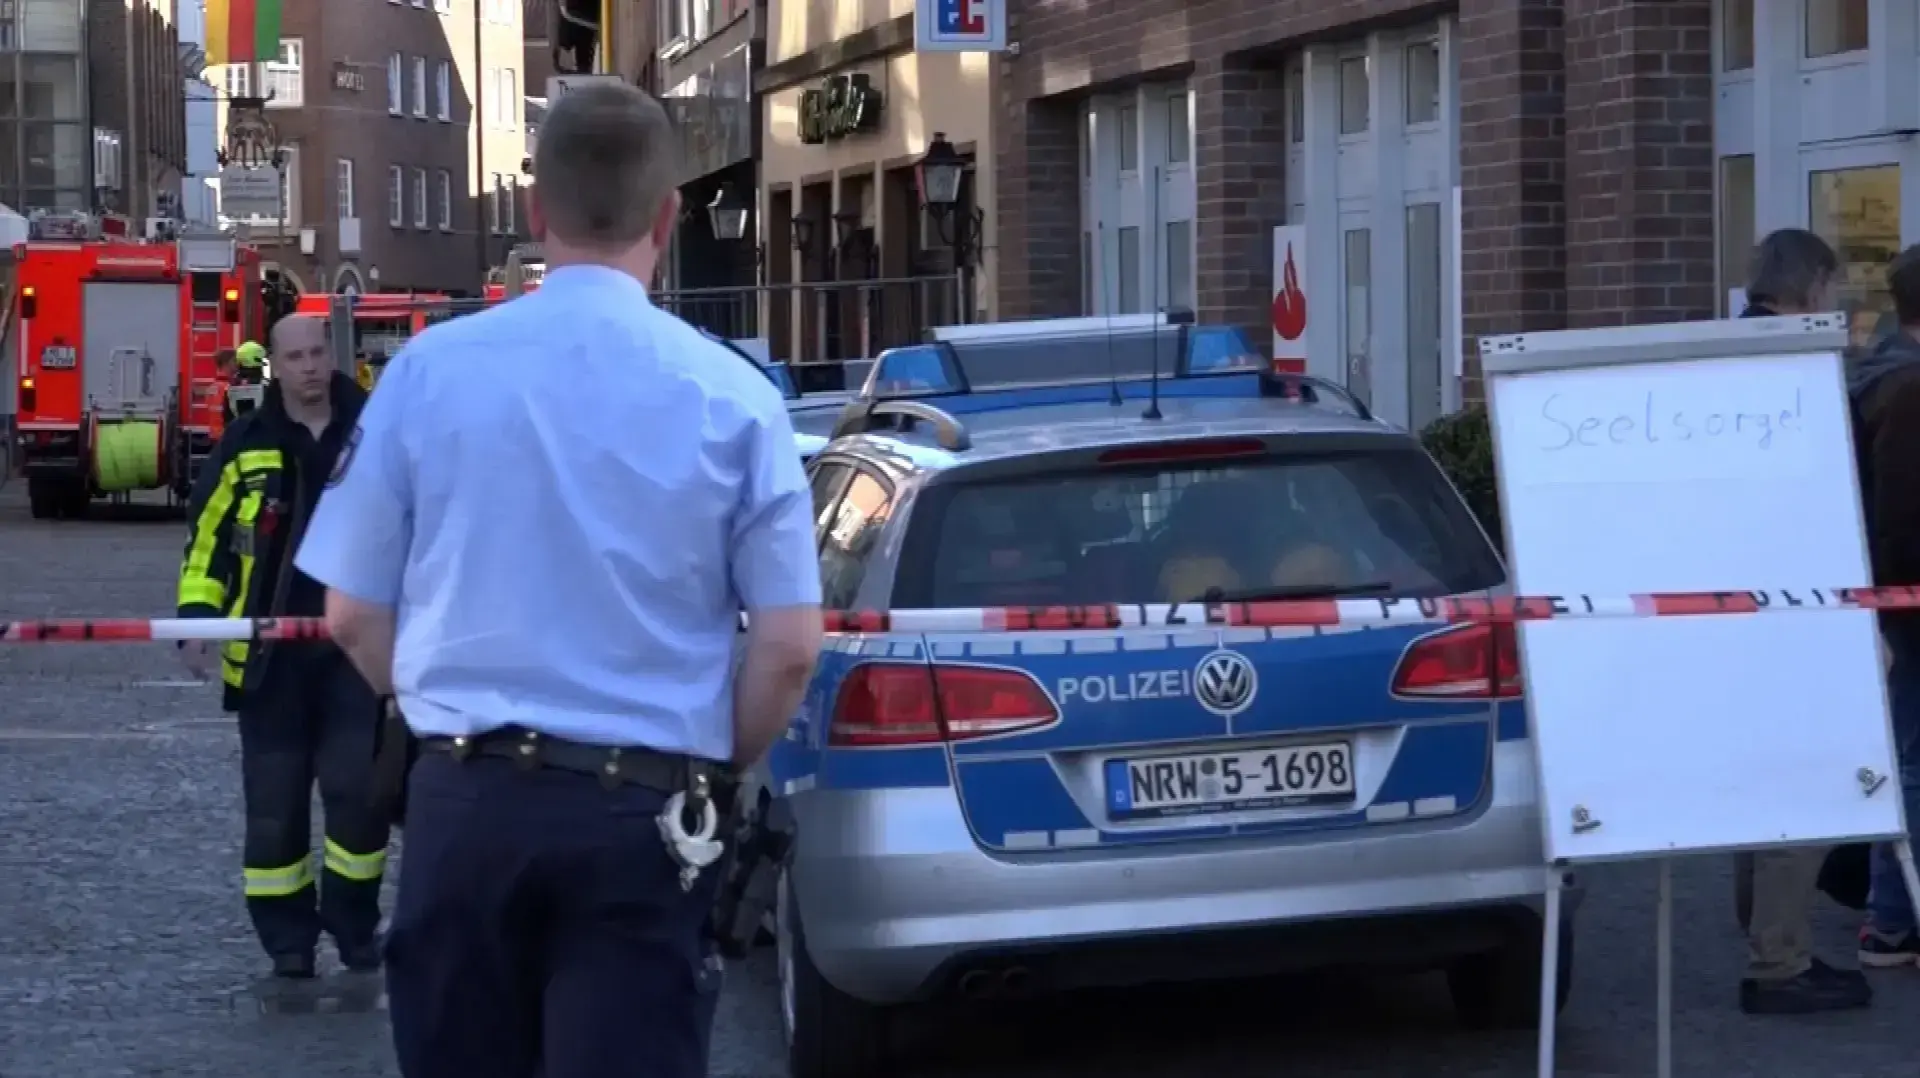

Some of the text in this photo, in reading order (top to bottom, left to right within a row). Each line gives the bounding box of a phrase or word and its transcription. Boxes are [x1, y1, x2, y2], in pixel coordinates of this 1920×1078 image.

[336, 71, 364, 90] HOTEL
[1058, 669, 1190, 704] POLIZEI
[1131, 760, 1199, 802] NRW
[1223, 749, 1347, 794] 5-1698
